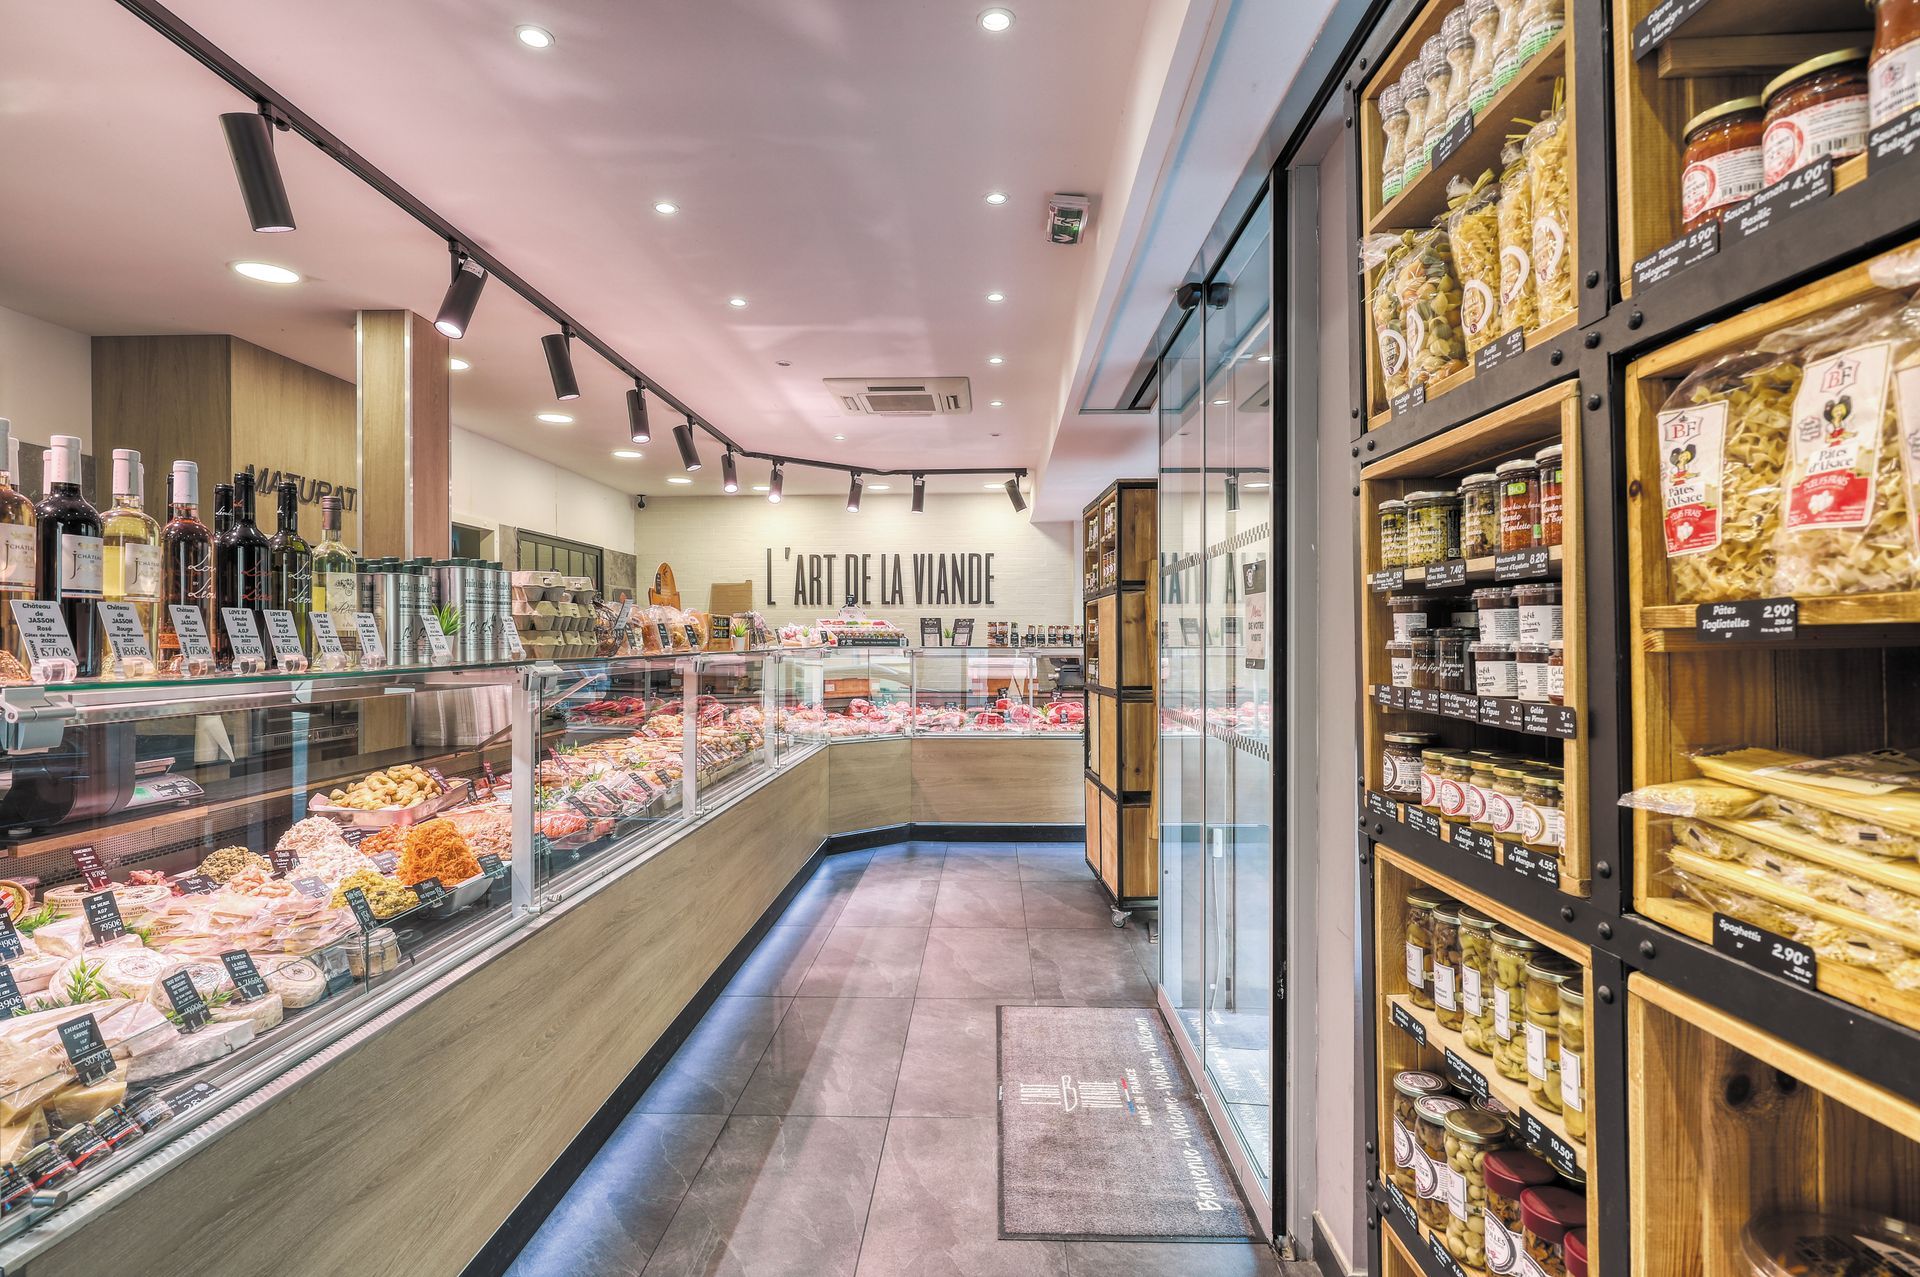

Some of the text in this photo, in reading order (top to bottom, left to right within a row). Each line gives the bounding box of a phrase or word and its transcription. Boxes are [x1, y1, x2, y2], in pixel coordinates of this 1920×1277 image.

[1639, 34, 1650, 47] au
[1869, 120, 1908, 148] Sauce
[1791, 161, 1830, 190] 4.90€
[1723, 181, 1790, 223] Sauce Tomate
[1740, 206, 1772, 231] Basilic
[1689, 225, 1717, 248] 5.90€
[1634, 239, 1687, 273] Sauce Tomate
[1827, 365, 1854, 389] BF
[1671, 420, 1697, 440] BF
[1668, 485, 1695, 498] Pâtes
[1496, 553, 1526, 564] Moutarde BIO
[1529, 552, 1548, 565] 8.20€
[845, 553, 872, 605] DE
[881, 553, 904, 605] LA
[913, 552, 995, 605] VIANDE
[1712, 604, 1736, 616] Pâtes
[1762, 603, 1796, 618] 2.90€
[1702, 618, 1750, 632] Tagliatelles
[1483, 699, 1497, 708] Confit
[1486, 708, 1500, 717] Figues
[1530, 706, 1544, 714] Gelée
[1531, 715, 1548, 724] Piment
[1513, 846, 1529, 858] Confit
[1515, 856, 1536, 869] Mangue
[1538, 859, 1557, 871] 4.55€
[1719, 918, 1762, 942] Spaghettis
[1771, 943, 1810, 966] 2.90€
[1149, 1056, 1173, 1090] Welkom
[1125, 1067, 1153, 1126] MADE IN FRANCE
[1166, 1094, 1193, 1140] Welcome
[1550, 1137, 1574, 1160] 10.50€
[1183, 1149, 1224, 1211] Bienvenue
